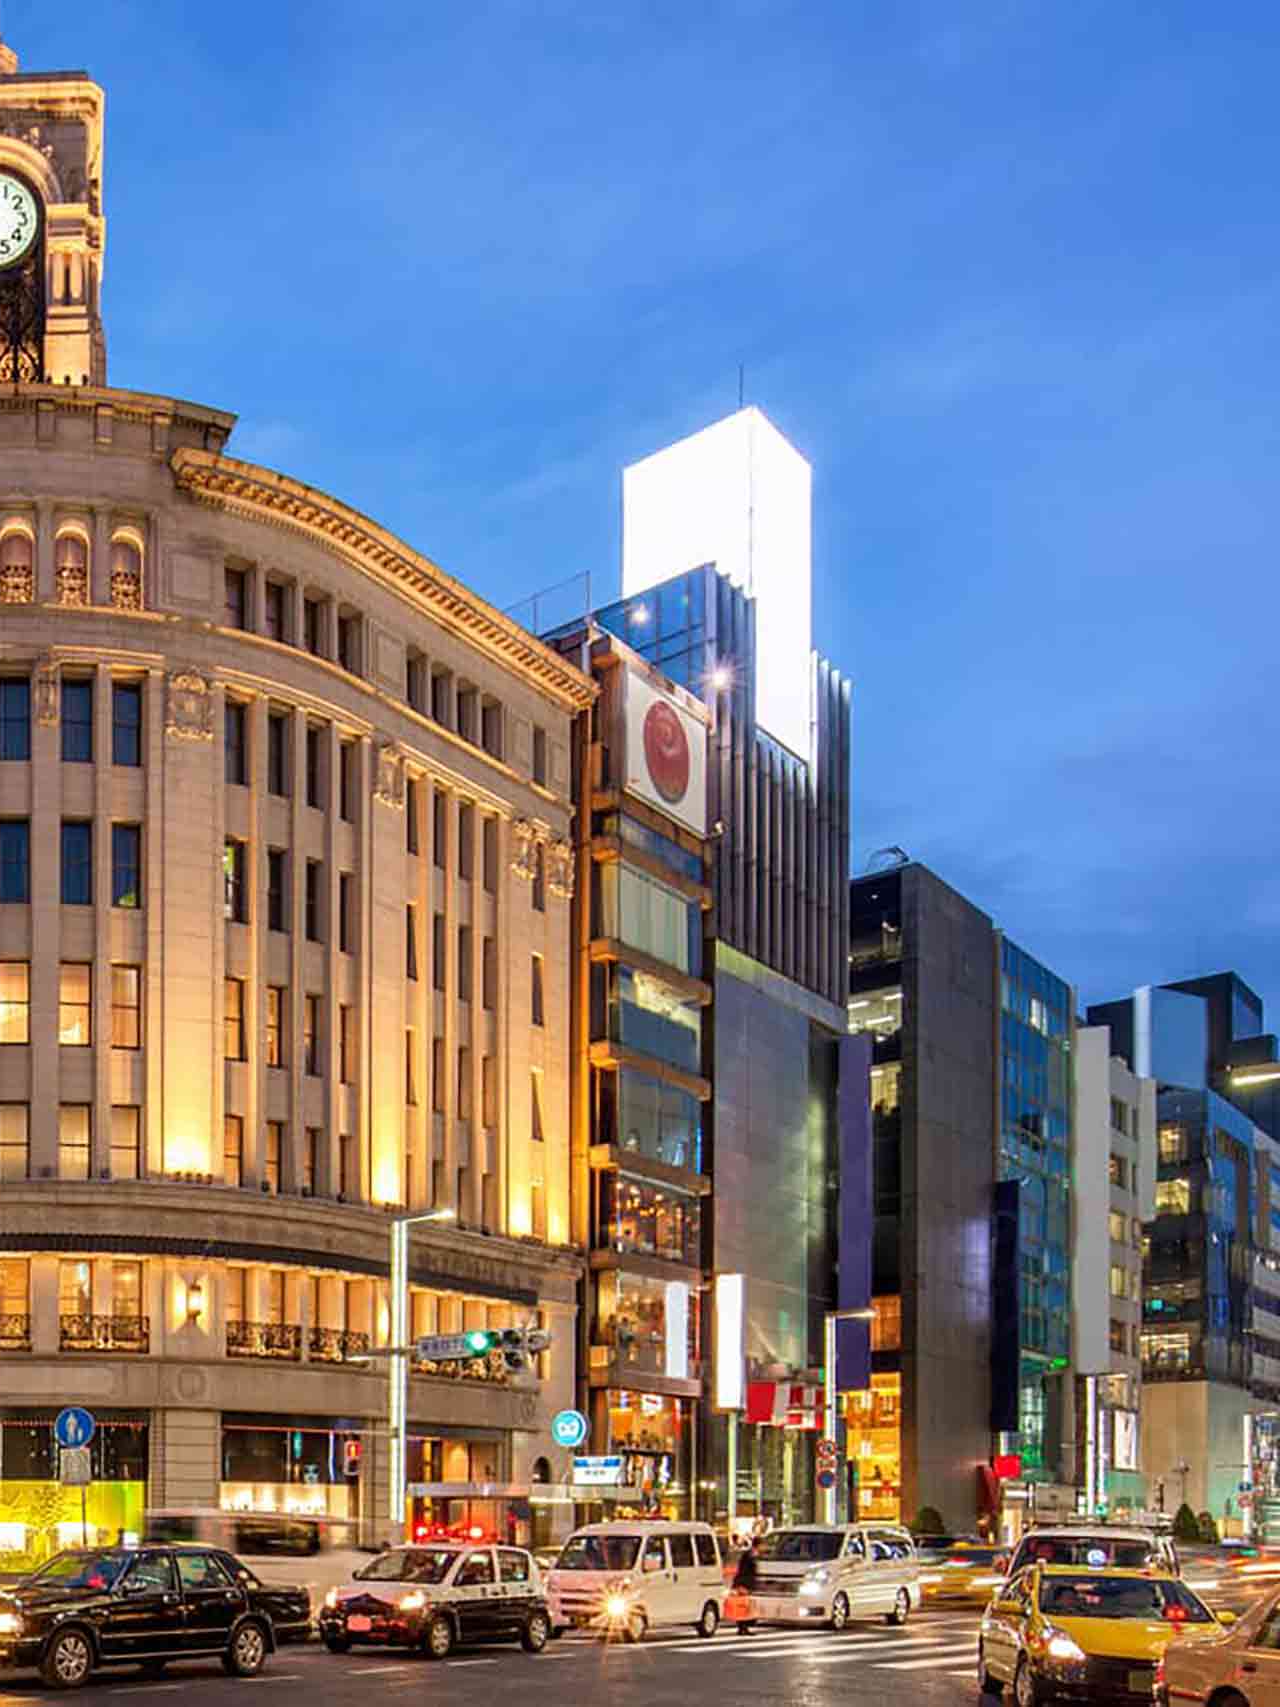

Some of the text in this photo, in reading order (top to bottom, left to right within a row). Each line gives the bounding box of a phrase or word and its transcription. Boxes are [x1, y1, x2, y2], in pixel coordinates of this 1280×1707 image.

[3, 184, 8, 199] 1
[11, 194, 23, 210] 2
[17, 211, 28, 227] 3
[11, 228, 22, 242] 4
[0, 239, 11, 255] 5
